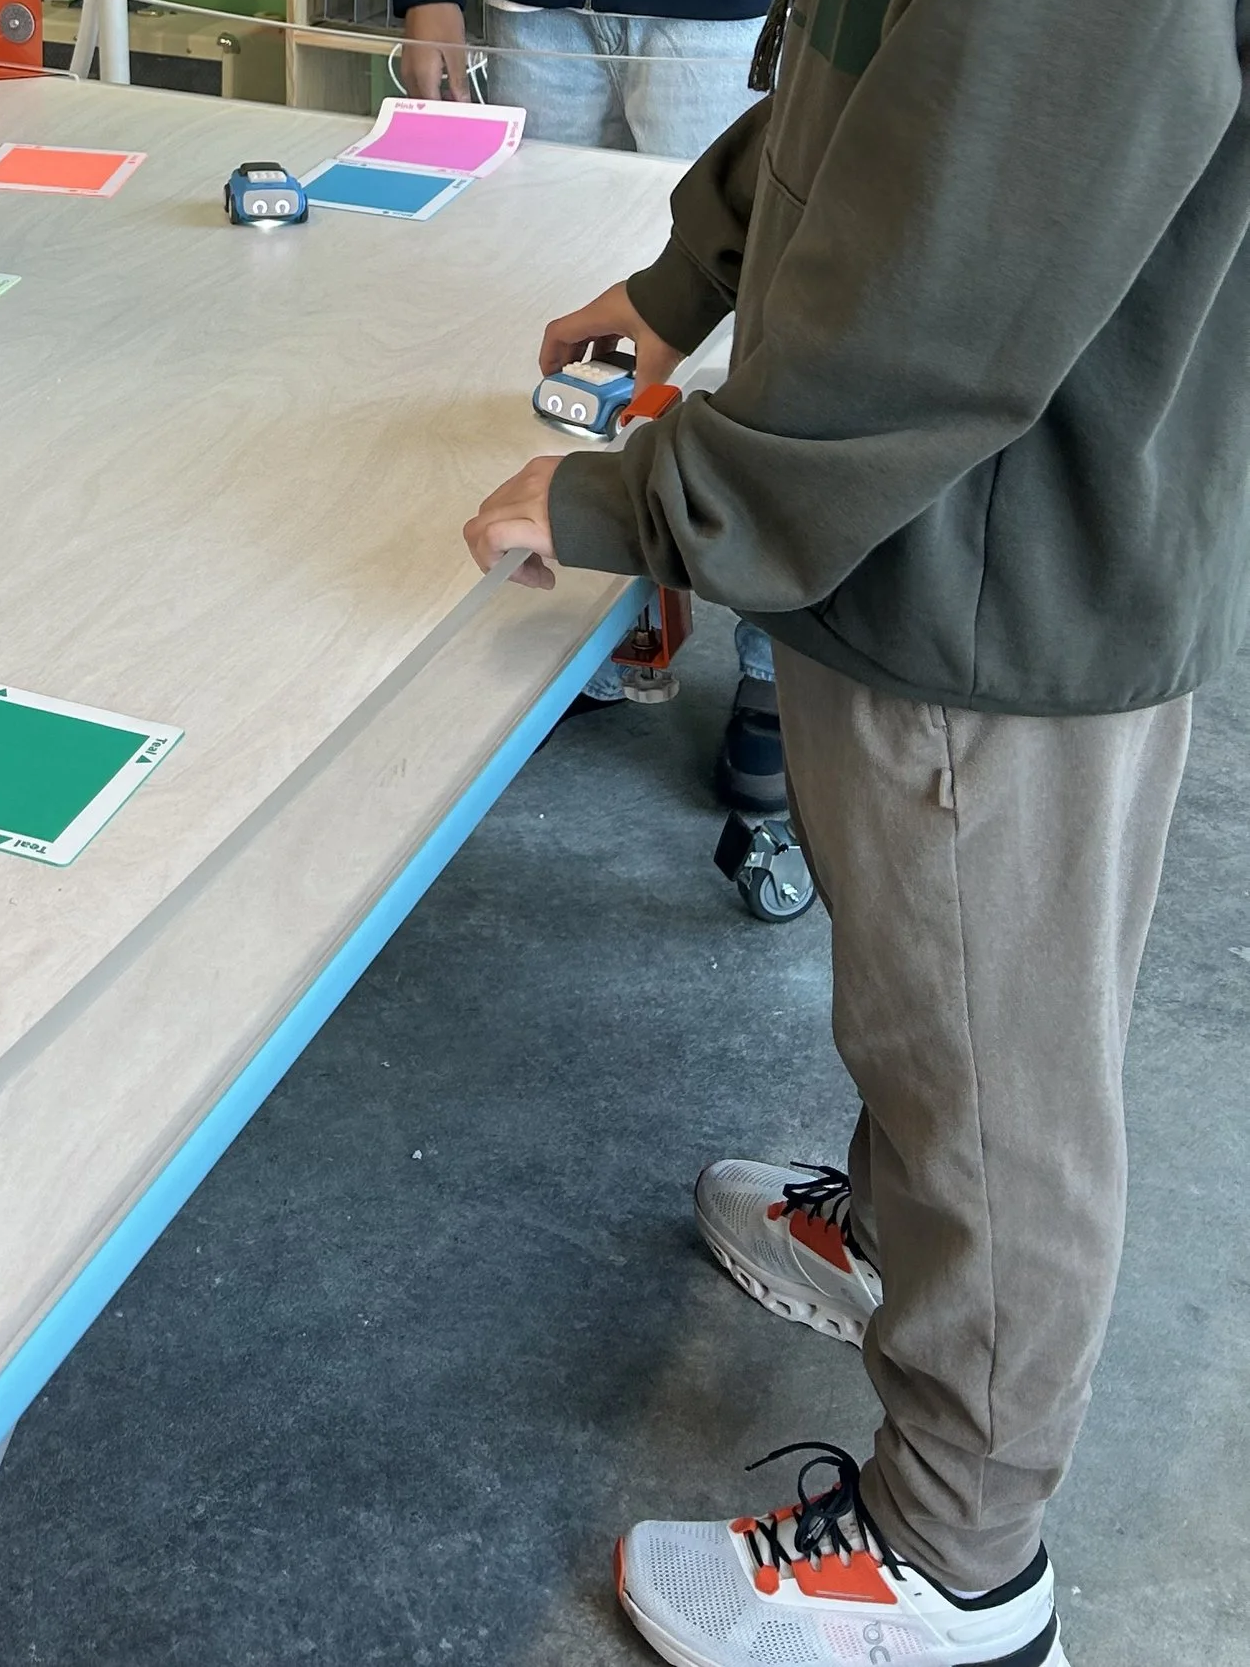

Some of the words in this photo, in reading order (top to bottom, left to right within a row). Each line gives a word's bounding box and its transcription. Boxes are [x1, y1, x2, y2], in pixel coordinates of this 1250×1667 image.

[395, 102, 414, 110] Pink
[145, 737, 168, 756] Teal
[13, 839, 48, 854] Teal
